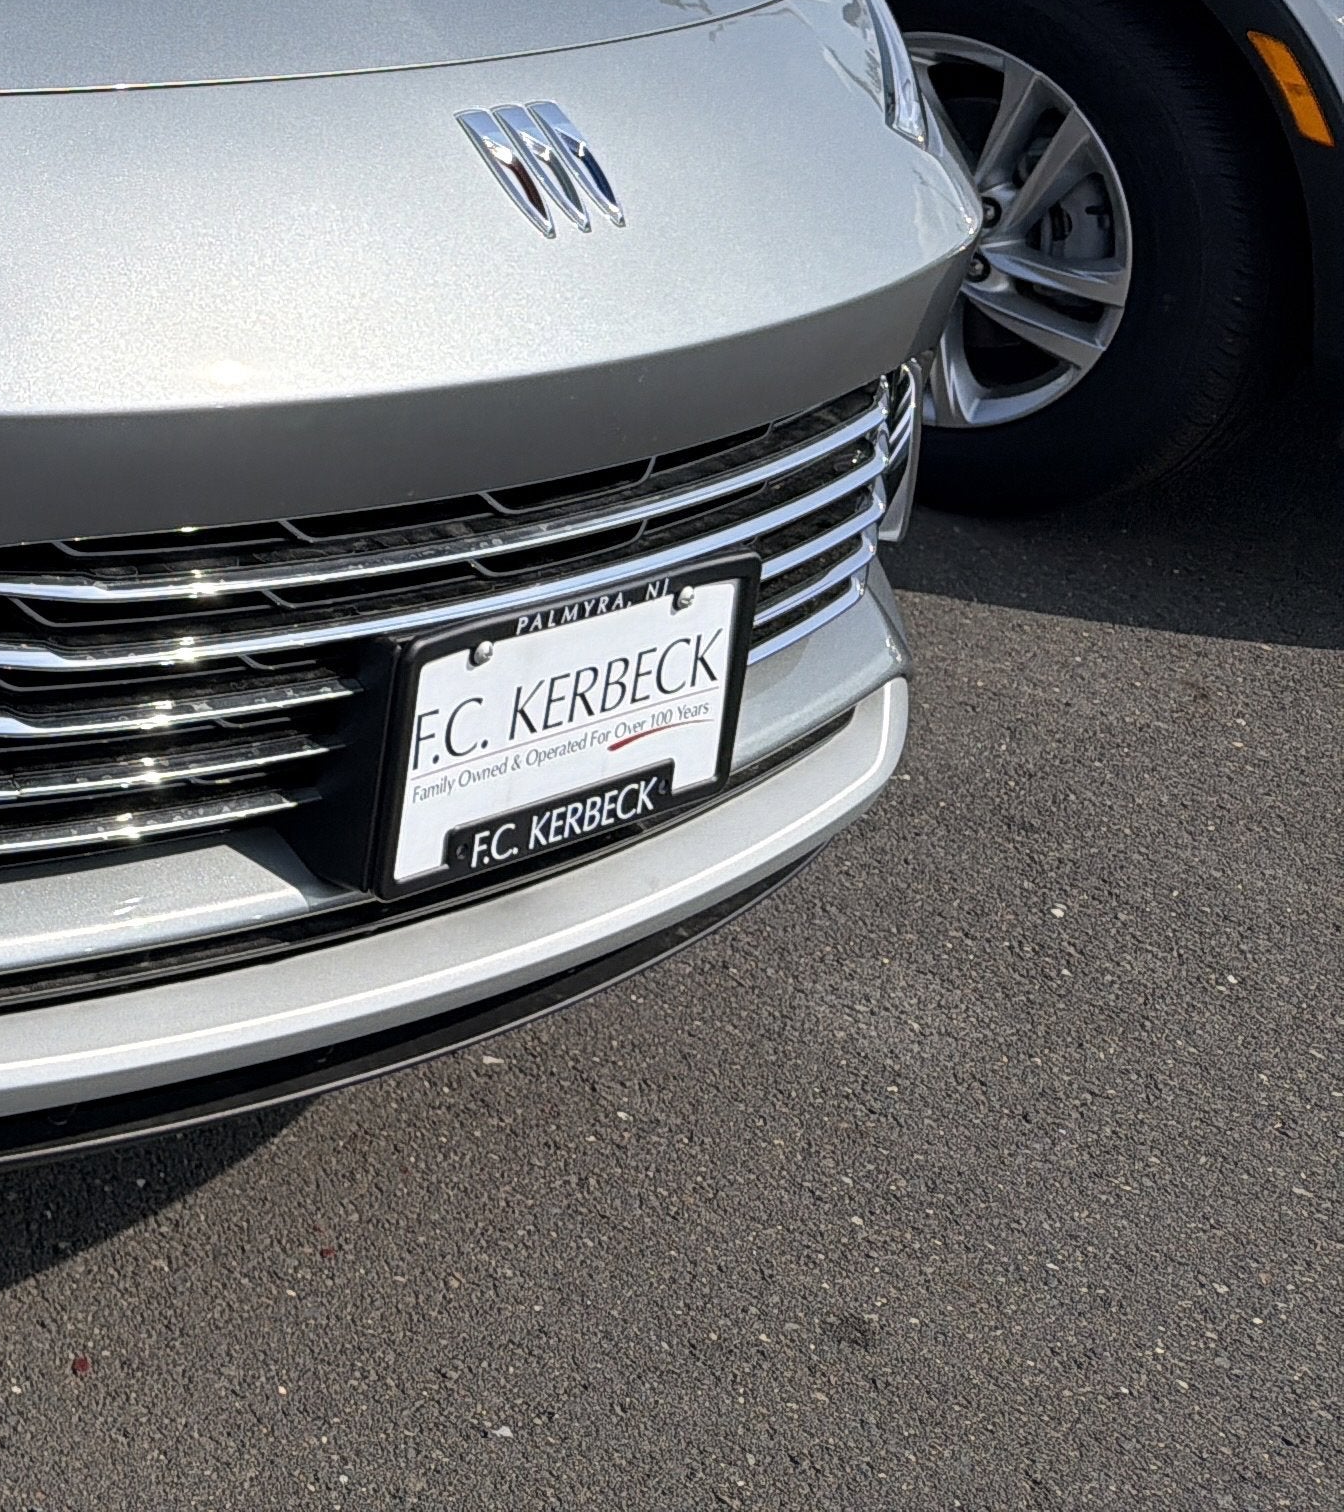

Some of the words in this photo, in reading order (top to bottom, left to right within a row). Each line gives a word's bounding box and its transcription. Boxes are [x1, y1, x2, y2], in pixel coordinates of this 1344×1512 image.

[515, 591, 632, 635] PALMYRA,
[412, 696, 489, 771] F.C.
[508, 627, 723, 741] KERBECK
[412, 776, 457, 804] Family
[458, 759, 508, 787] Owned
[511, 753, 521, 771] &
[525, 736, 587, 768] Operated
[590, 728, 611, 746] For
[614, 719, 646, 739] Over
[650, 709, 673, 729] 100
[677, 700, 710, 721] Years
[470, 823, 519, 868] F.C.
[528, 776, 658, 850] KERBECK
